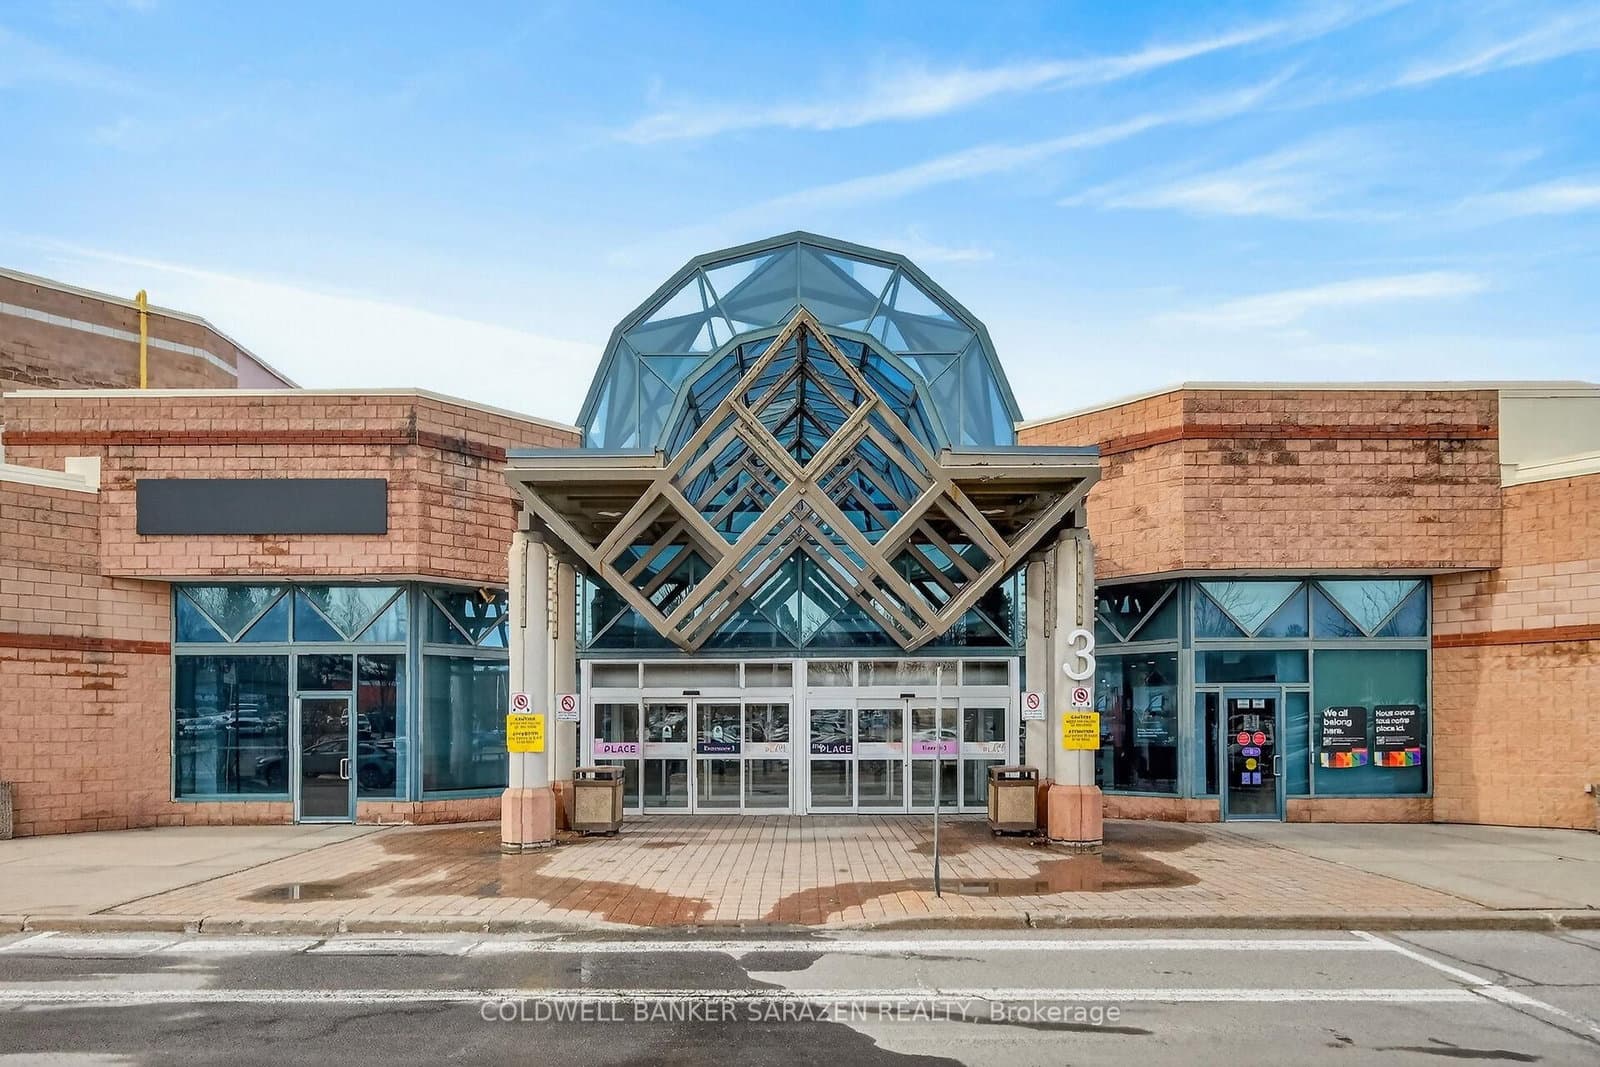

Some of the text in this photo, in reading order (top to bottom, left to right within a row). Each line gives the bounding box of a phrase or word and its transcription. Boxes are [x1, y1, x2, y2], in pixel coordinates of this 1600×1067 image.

[1062, 629, 1096, 681] 3
[1323, 709, 1348, 717] We all
[1323, 718, 1352, 727] belong
[604, 745, 636, 753] PLACE
[819, 745, 851, 753] PLACE
